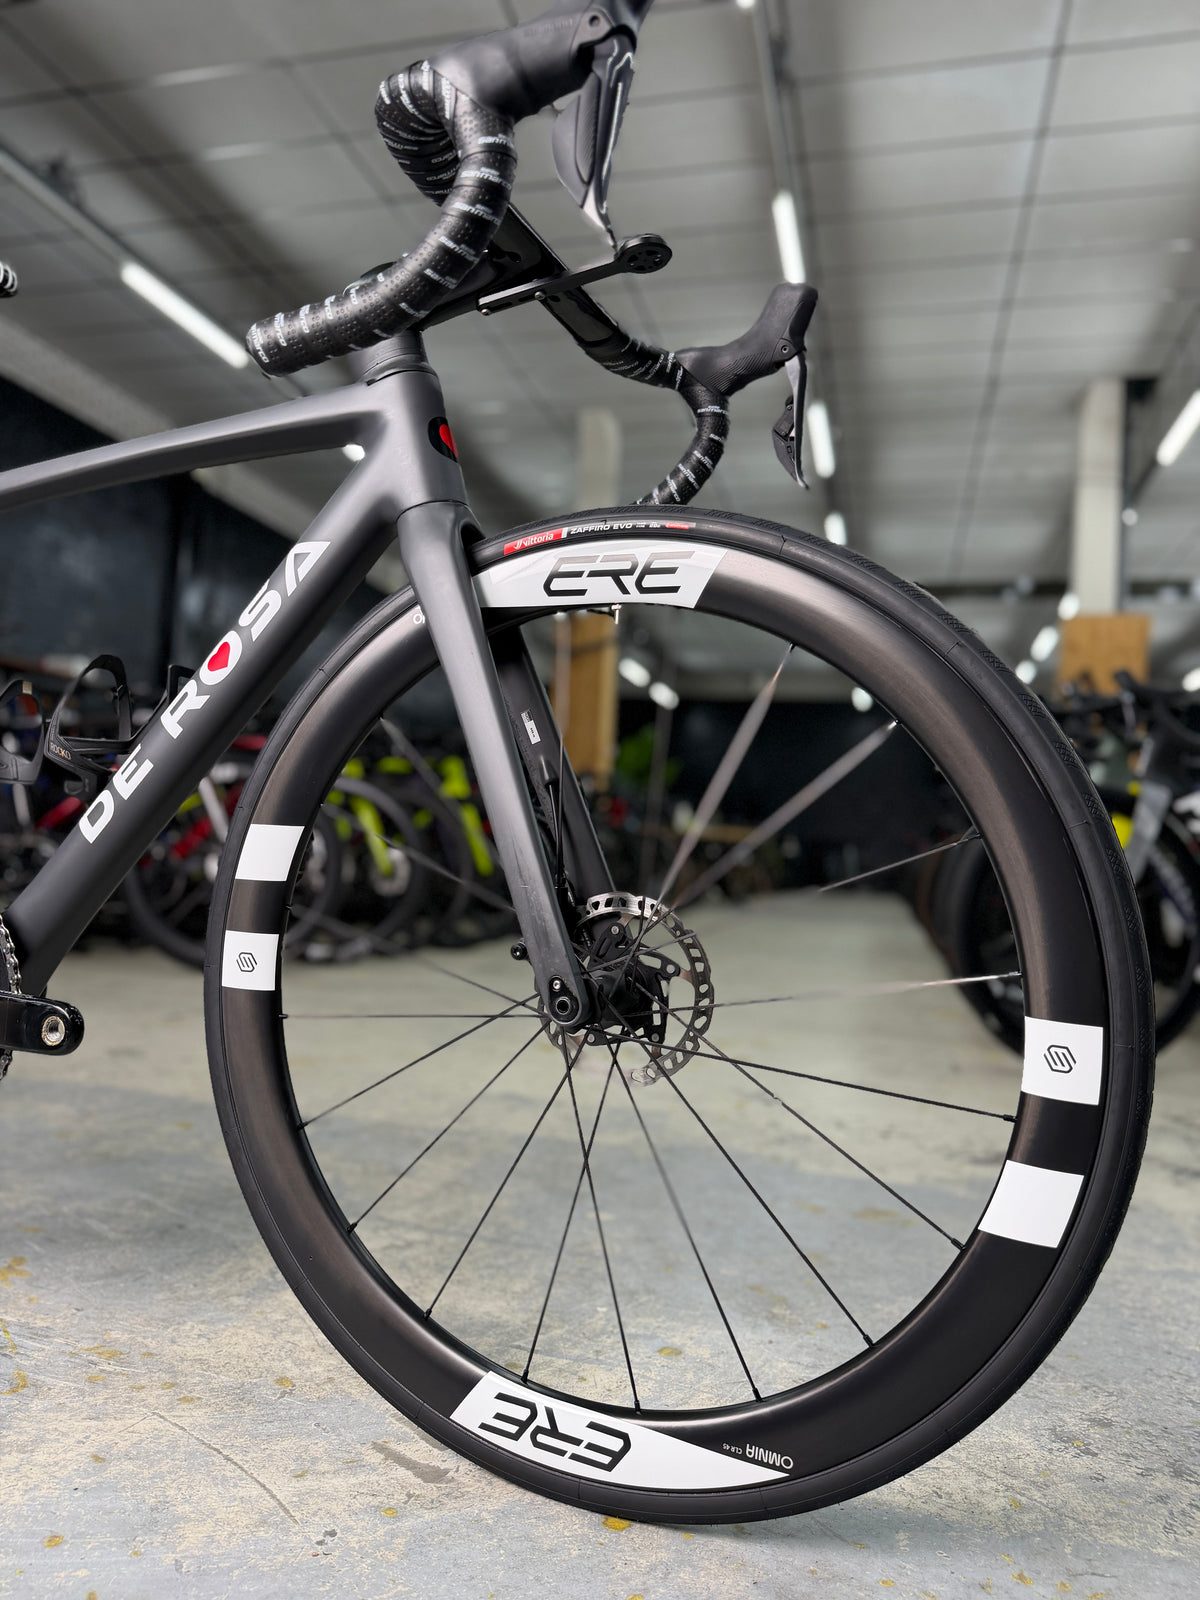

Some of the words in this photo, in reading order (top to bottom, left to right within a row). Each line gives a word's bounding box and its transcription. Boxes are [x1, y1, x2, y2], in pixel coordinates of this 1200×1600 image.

[523, 532, 554, 548] vittoria
[570, 523, 611, 535] ZAFFIRO
[613, 521, 633, 531] EVO
[543, 551, 696, 597] ERE
[79, 743, 154, 844] DE
[161, 541, 331, 740] ROSA
[478, 1392, 631, 1472] ERE
[730, 1445, 743, 1455] CLR
[745, 1443, 794, 1470] OMNIA
